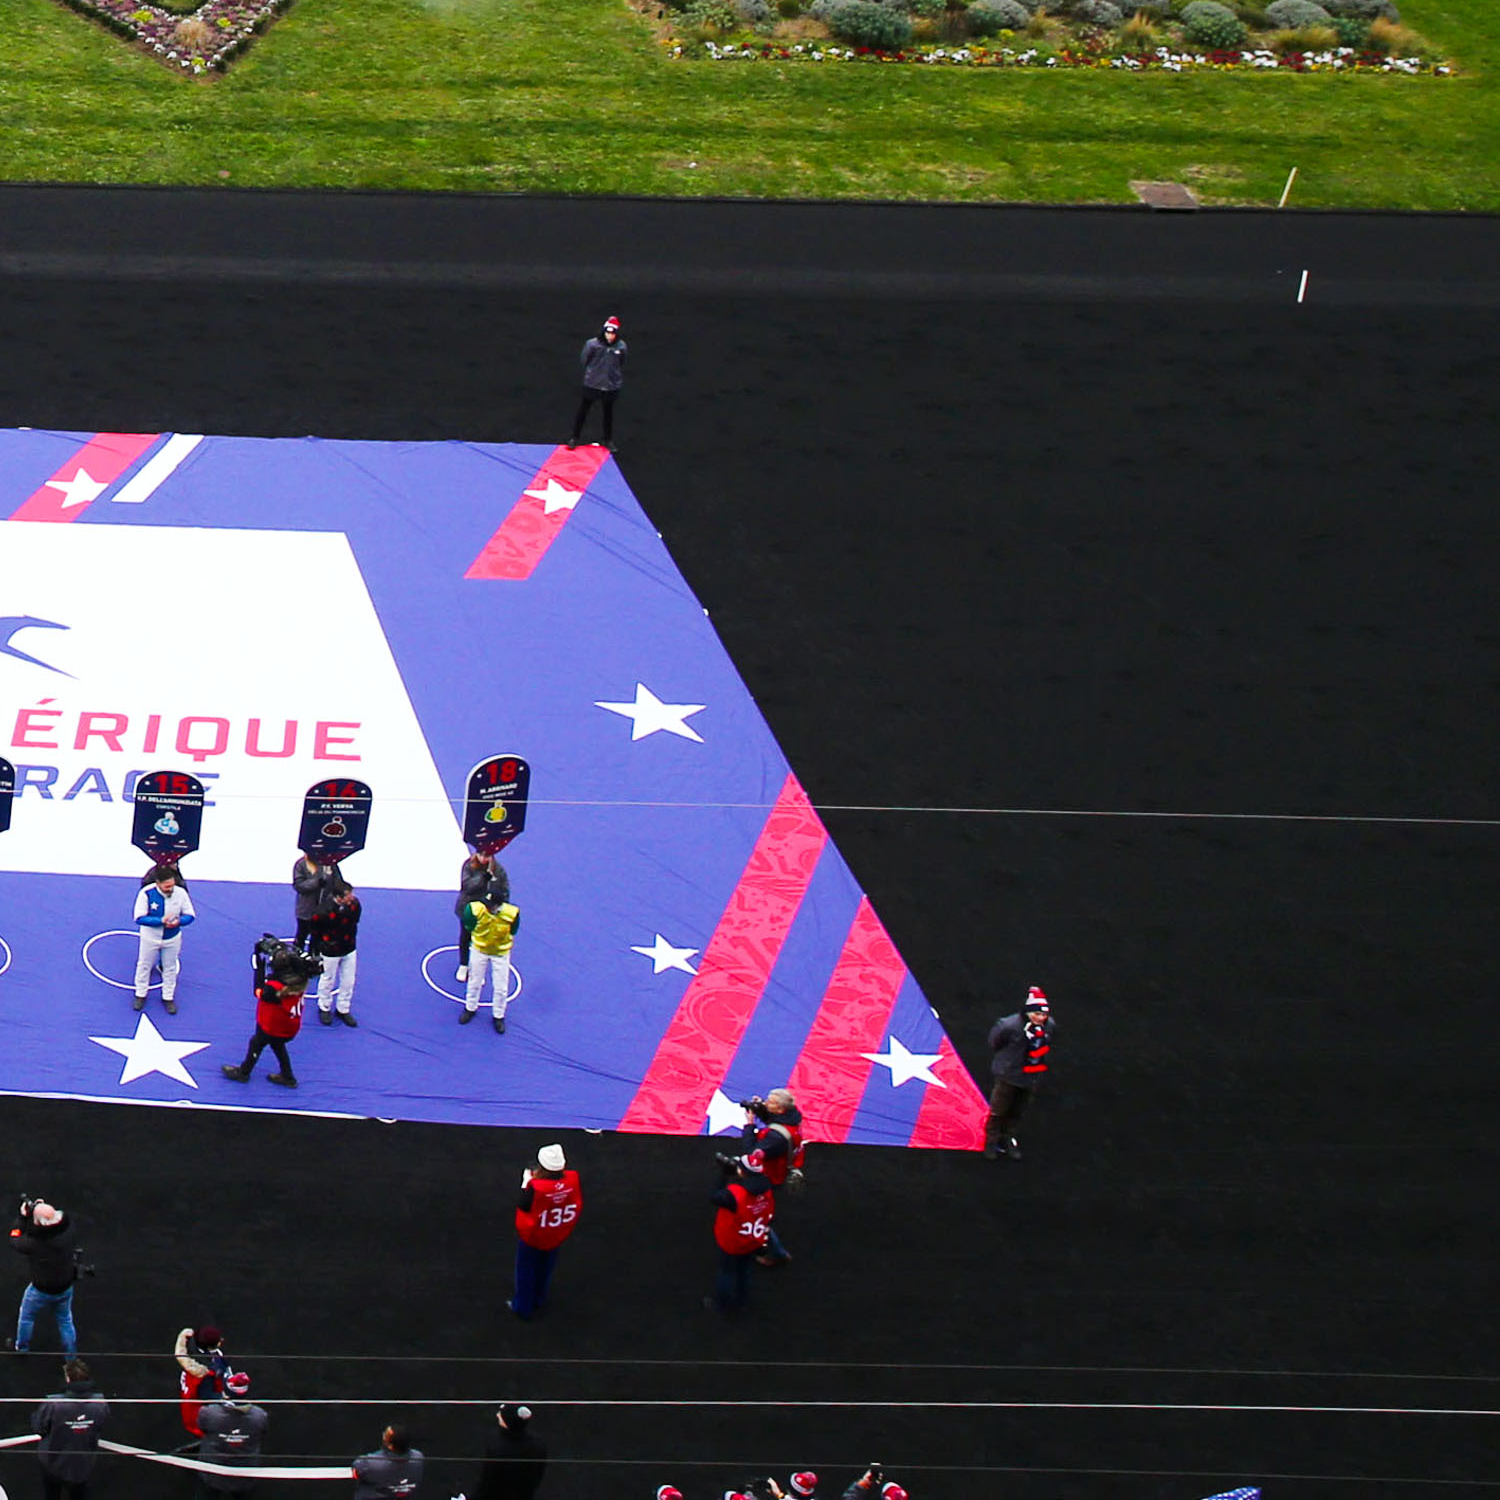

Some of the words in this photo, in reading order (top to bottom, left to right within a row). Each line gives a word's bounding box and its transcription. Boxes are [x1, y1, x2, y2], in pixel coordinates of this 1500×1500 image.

[487, 760, 518, 785] 18
[155, 774, 190, 795] 15
[325, 782, 358, 802] 16
[539, 1204, 577, 1228] 135
